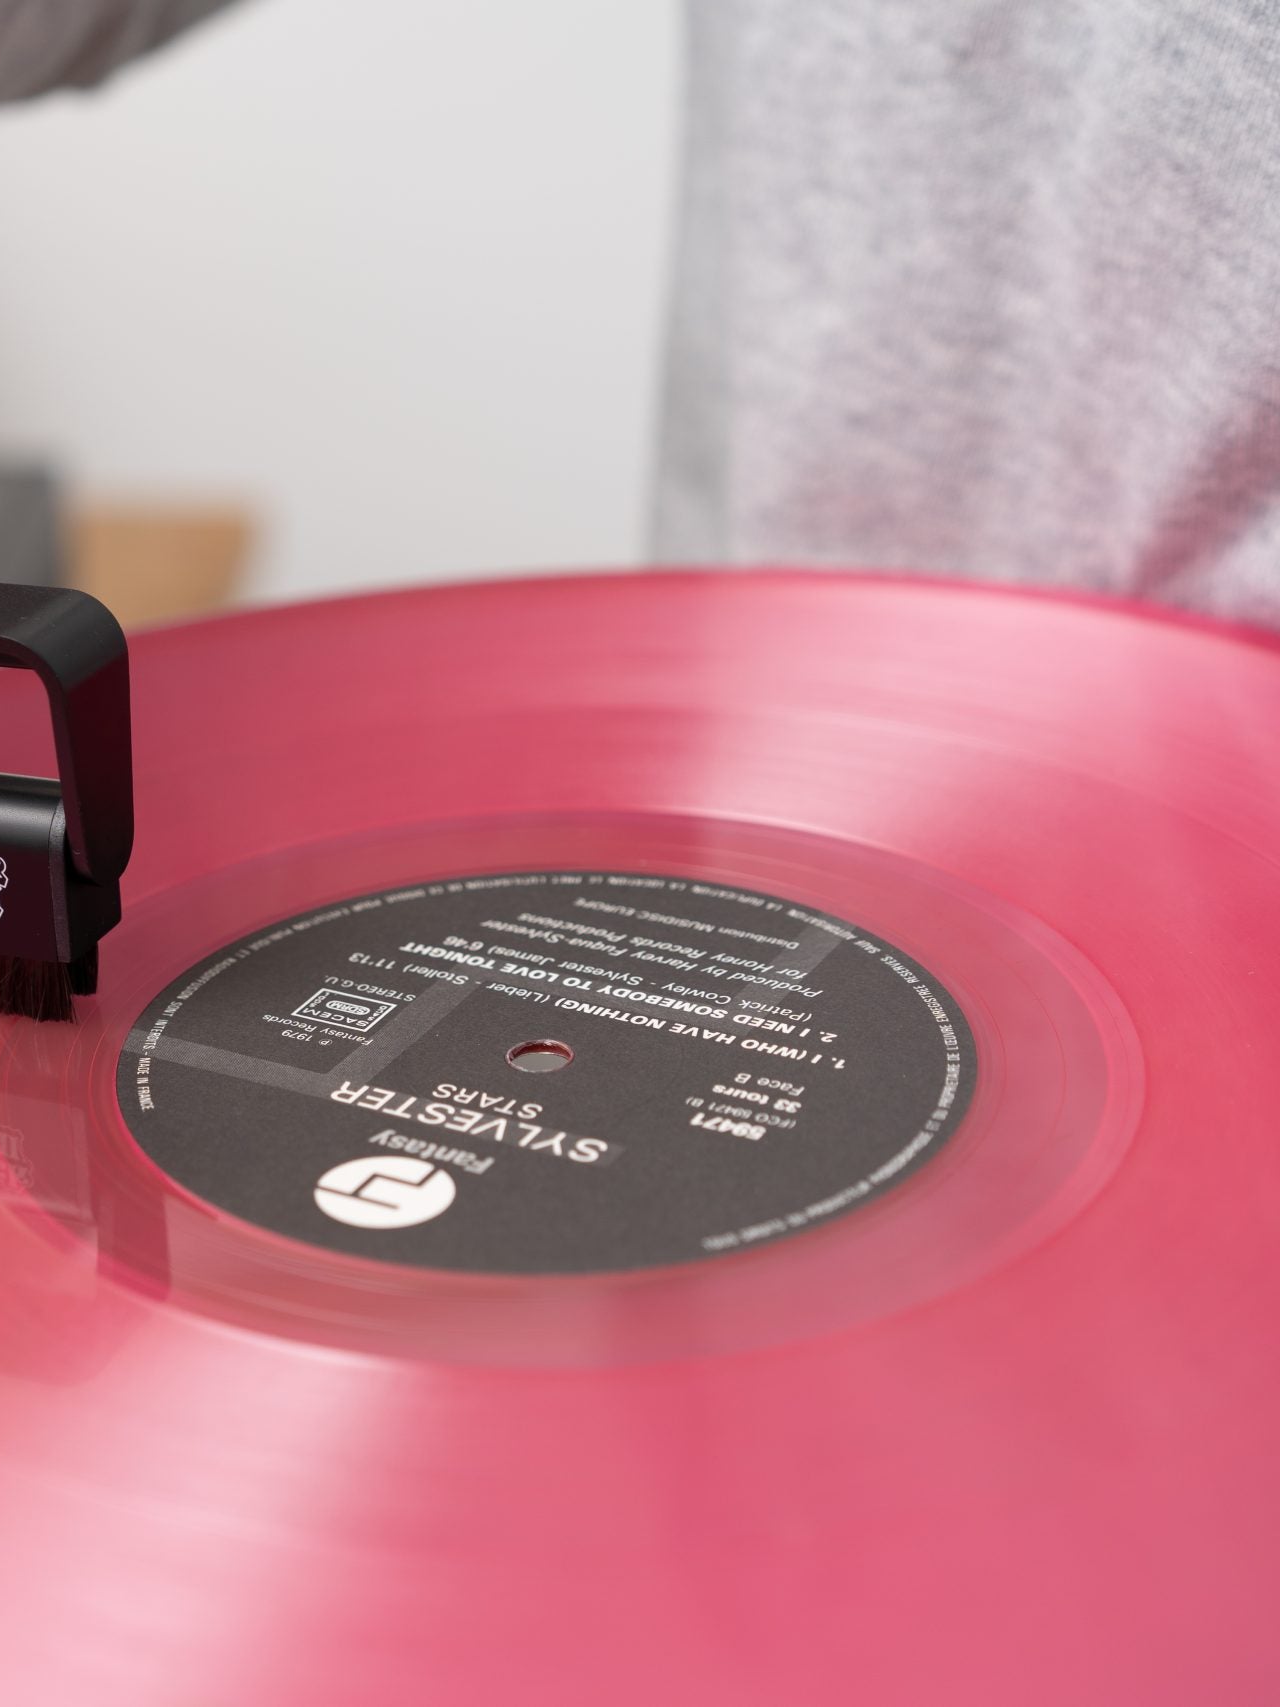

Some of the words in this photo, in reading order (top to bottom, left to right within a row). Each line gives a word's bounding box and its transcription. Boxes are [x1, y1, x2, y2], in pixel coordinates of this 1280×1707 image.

[516, 912, 627, 943] Productions
[443, 936, 484, 951] 6'46
[628, 936, 707, 959] Records
[718, 927, 799, 950] Distribution
[348, 952, 396, 969] 11'13
[398, 942, 496, 969] TONIGHT
[487, 945, 555, 966] James)
[629, 950, 697, 971] Harvey
[710, 952, 773, 974] Honey
[403, 964, 469, 985] Stoller)
[500, 963, 558, 982] LOVE
[557, 961, 643, 985] Sylvester
[700, 966, 727, 977] by
[776, 967, 807, 980] for
[486, 982, 550, 1003] (Lieber
[562, 977, 592, 990] TO
[660, 982, 731, 1005] Cowley
[726, 971, 823, 998] Produced
[162, 1001, 182, 1017] SONT
[330, 1002, 365, 1014] SDRM
[597, 985, 728, 1019] SOMEBODY
[737, 999, 812, 1022] (Patrick
[262, 1014, 317, 1032] Records
[302, 1008, 369, 1027] SACEM
[554, 997, 666, 1029] NOTHING)
[668, 1023, 736, 1044] HAVE
[732, 1014, 795, 1034] NEED
[799, 1028, 810, 1037] I
[281, 1029, 312, 1042] 1979
[319, 1028, 373, 1046] Fantasy
[819, 1031, 837, 1042] 2.
[740, 1039, 807, 1060] (WHO
[811, 1054, 822, 1064] I
[136, 1057, 150, 1074] MADE
[831, 1057, 845, 1069] 1.
[734, 1073, 751, 1084] B
[757, 1077, 804, 1096] Face
[431, 1083, 542, 1119] STARS
[712, 1084, 769, 1104] tours
[773, 1099, 801, 1113] 33
[330, 1081, 608, 1163] SYLVESTER
[689, 1112, 766, 1141] 59471
[368, 1129, 494, 1175] Fantasy
